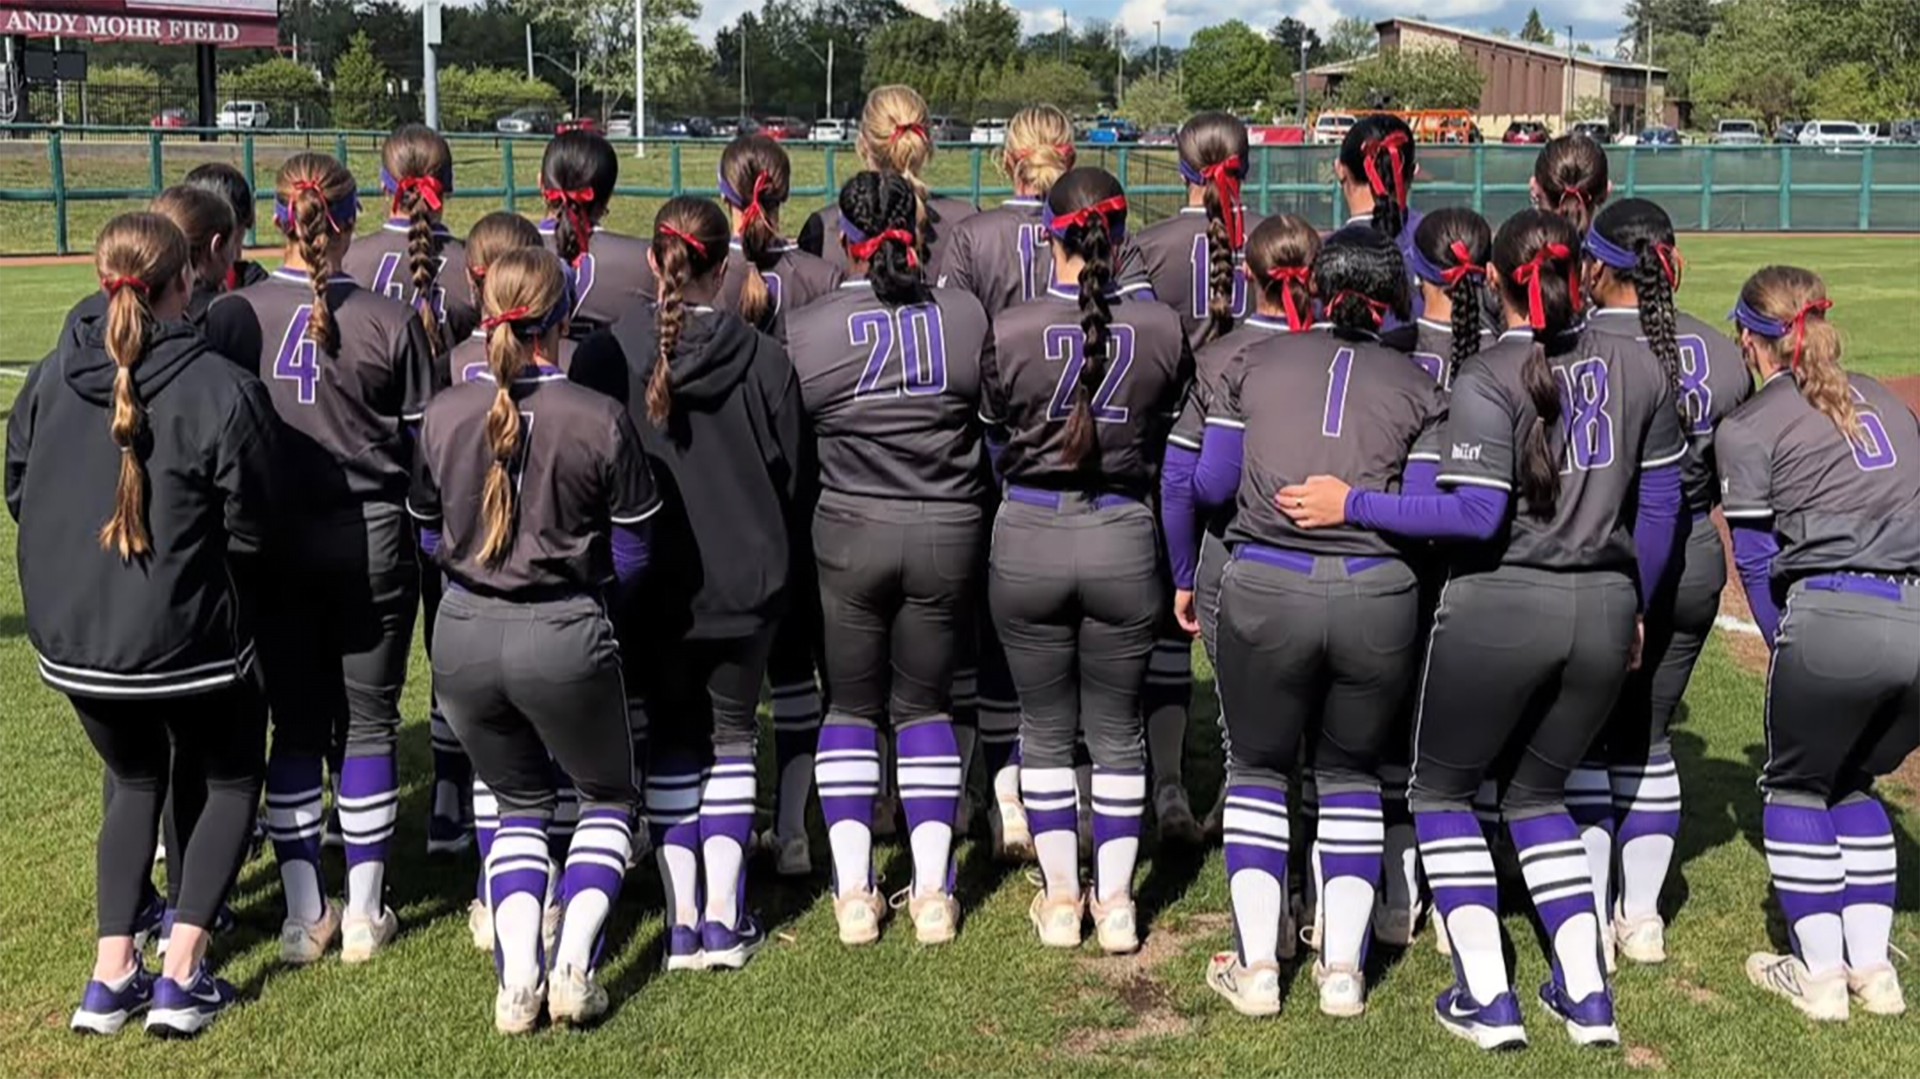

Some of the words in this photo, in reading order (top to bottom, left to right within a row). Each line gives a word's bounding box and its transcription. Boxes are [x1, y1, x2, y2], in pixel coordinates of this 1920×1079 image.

[5, 11, 79, 33] ANDY
[86, 16, 162, 38] MOHR
[168, 20, 239, 42] FIELD
[273, 304, 320, 404] 4
[848, 301, 947, 401] 20
[1044, 323, 1135, 423] 22
[1322, 347, 1354, 437] 1
[1550, 356, 1614, 475] 18
